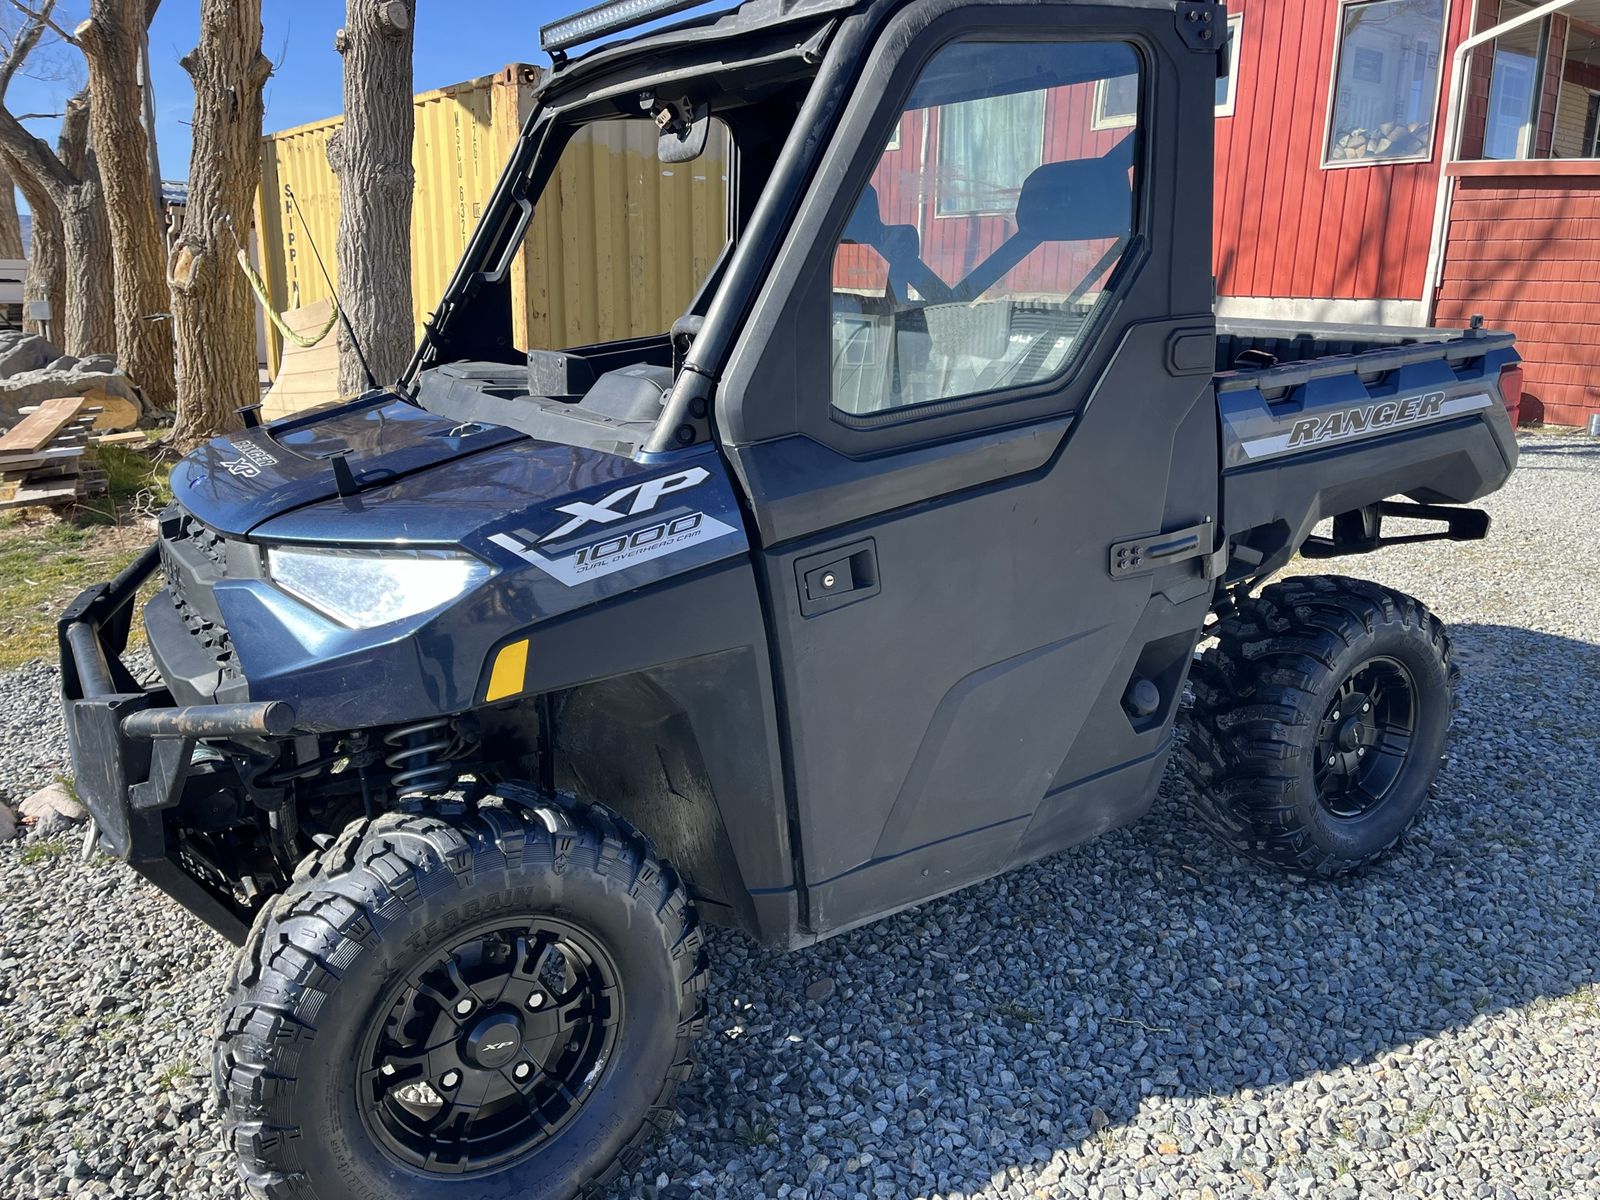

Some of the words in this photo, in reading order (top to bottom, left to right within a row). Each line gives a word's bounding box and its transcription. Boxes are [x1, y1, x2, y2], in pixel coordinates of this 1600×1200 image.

[1286, 391, 1446, 448] RANGER
[219, 457, 262, 478] XP
[532, 466, 711, 544] XP
[574, 511, 704, 568] 1000
[576, 560, 609, 574] DUAL
[612, 538, 675, 563] OVERHEAD
[676, 529, 702, 543] CAM
[481, 1041, 514, 1052] XP
